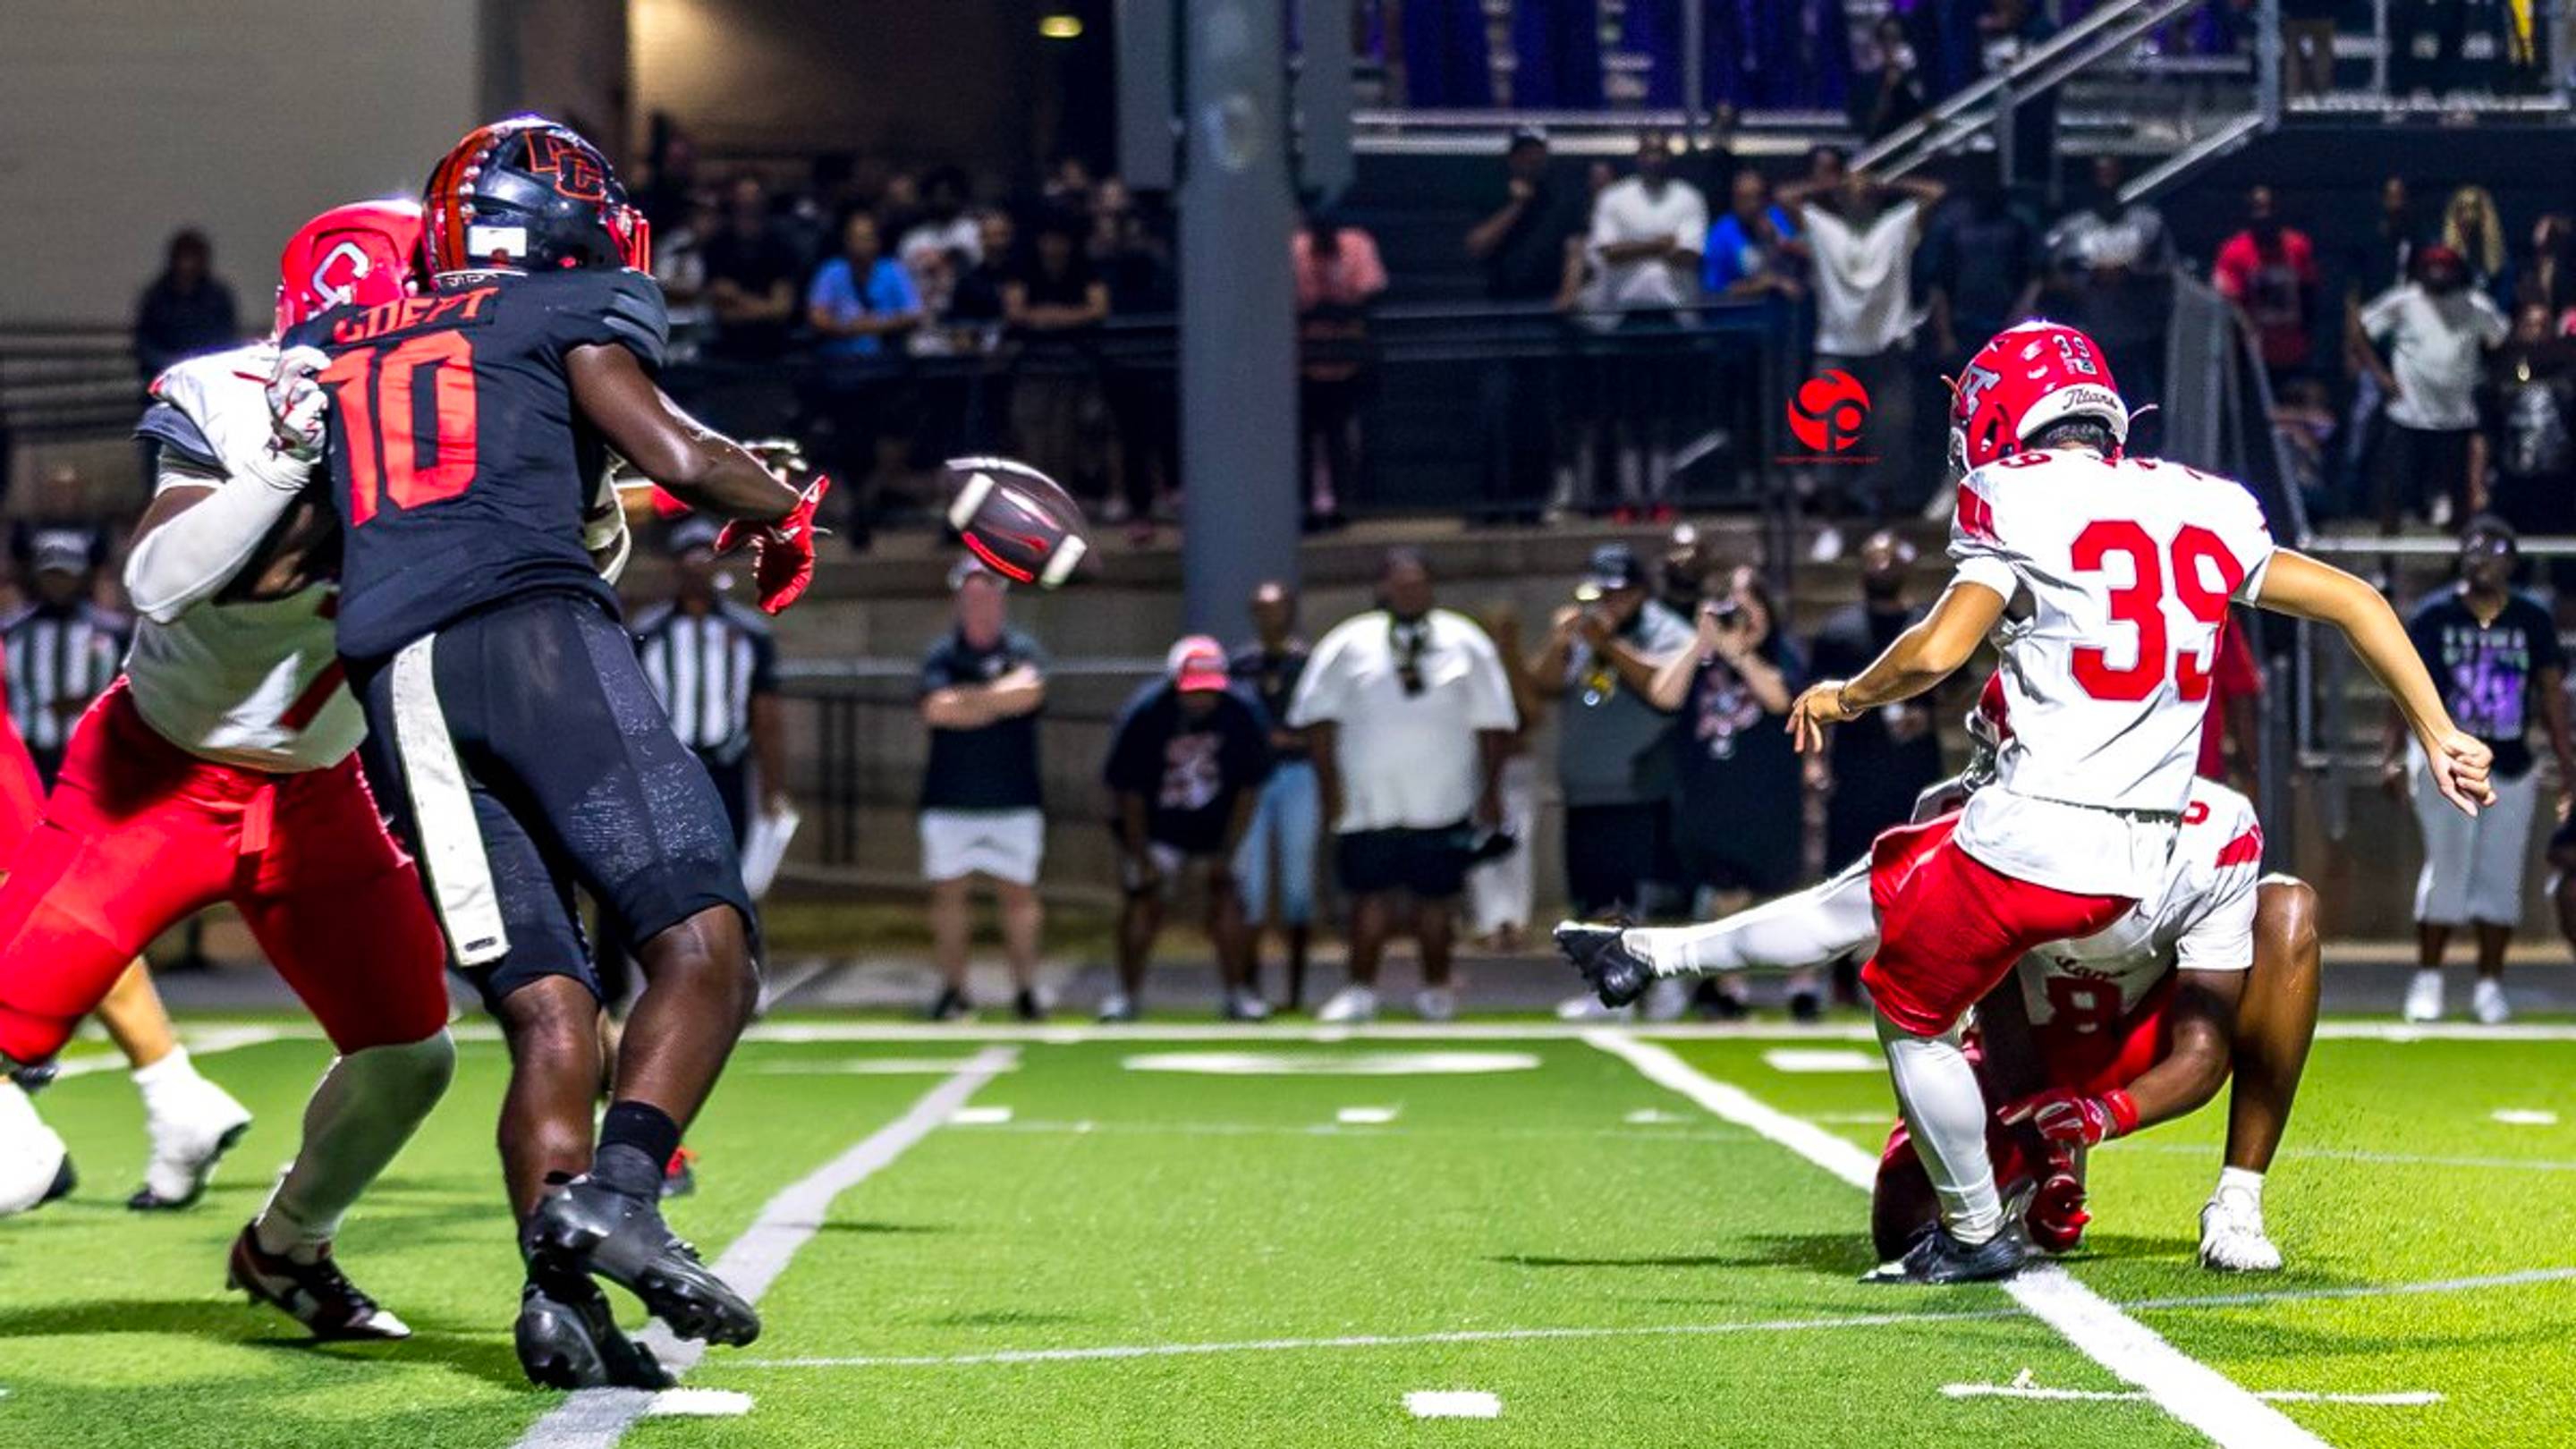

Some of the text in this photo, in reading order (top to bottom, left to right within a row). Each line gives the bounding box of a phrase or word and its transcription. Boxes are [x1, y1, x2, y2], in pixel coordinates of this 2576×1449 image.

[311, 240, 372, 307] C
[2052, 334, 2090, 358] 39
[1962, 364, 2001, 421] A
[2062, 387, 2118, 411] Titans
[318, 329, 477, 529] 10
[2071, 519, 2244, 701] 39
